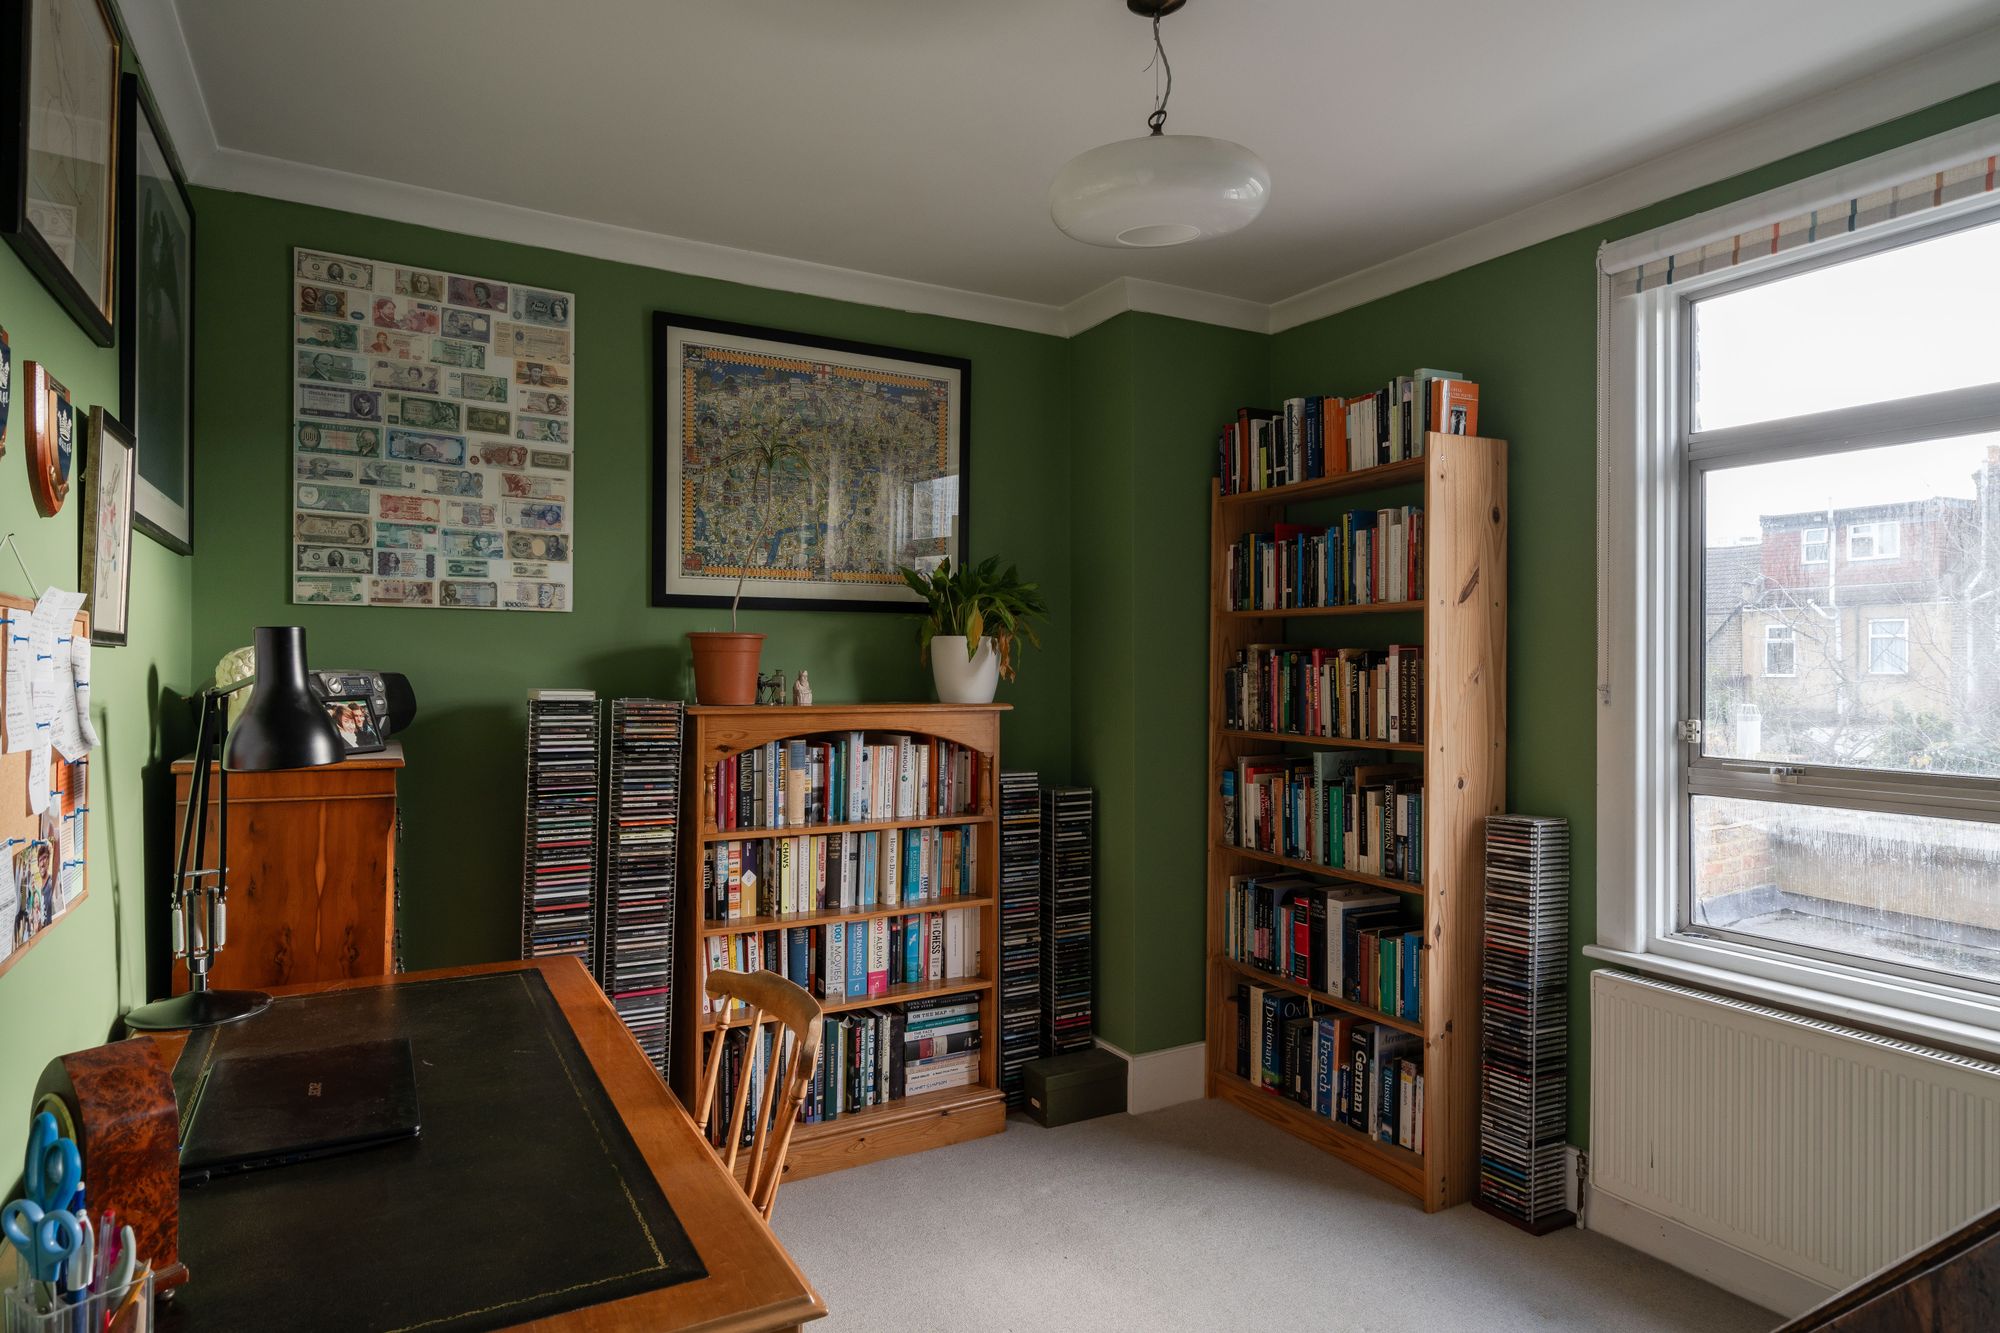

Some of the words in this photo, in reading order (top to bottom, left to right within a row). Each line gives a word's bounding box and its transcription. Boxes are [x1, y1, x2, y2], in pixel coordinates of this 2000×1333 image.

[318, 527, 347, 537] CANADA
[741, 753, 753, 792] STALINGRAD
[889, 855, 896, 863] to
[834, 924, 842, 943] 1001
[931, 930, 941, 955] CHESS
[834, 946, 842, 981] MOVIES
[855, 939, 863, 976] PAINTINGS
[1284, 1000, 1328, 1018] Oxfrd
[1262, 1006, 1275, 1070] Dictionary
[1319, 1040, 1332, 1092] French
[1353, 1049, 1367, 1113] German
[1383, 1075, 1393, 1113] Russian
